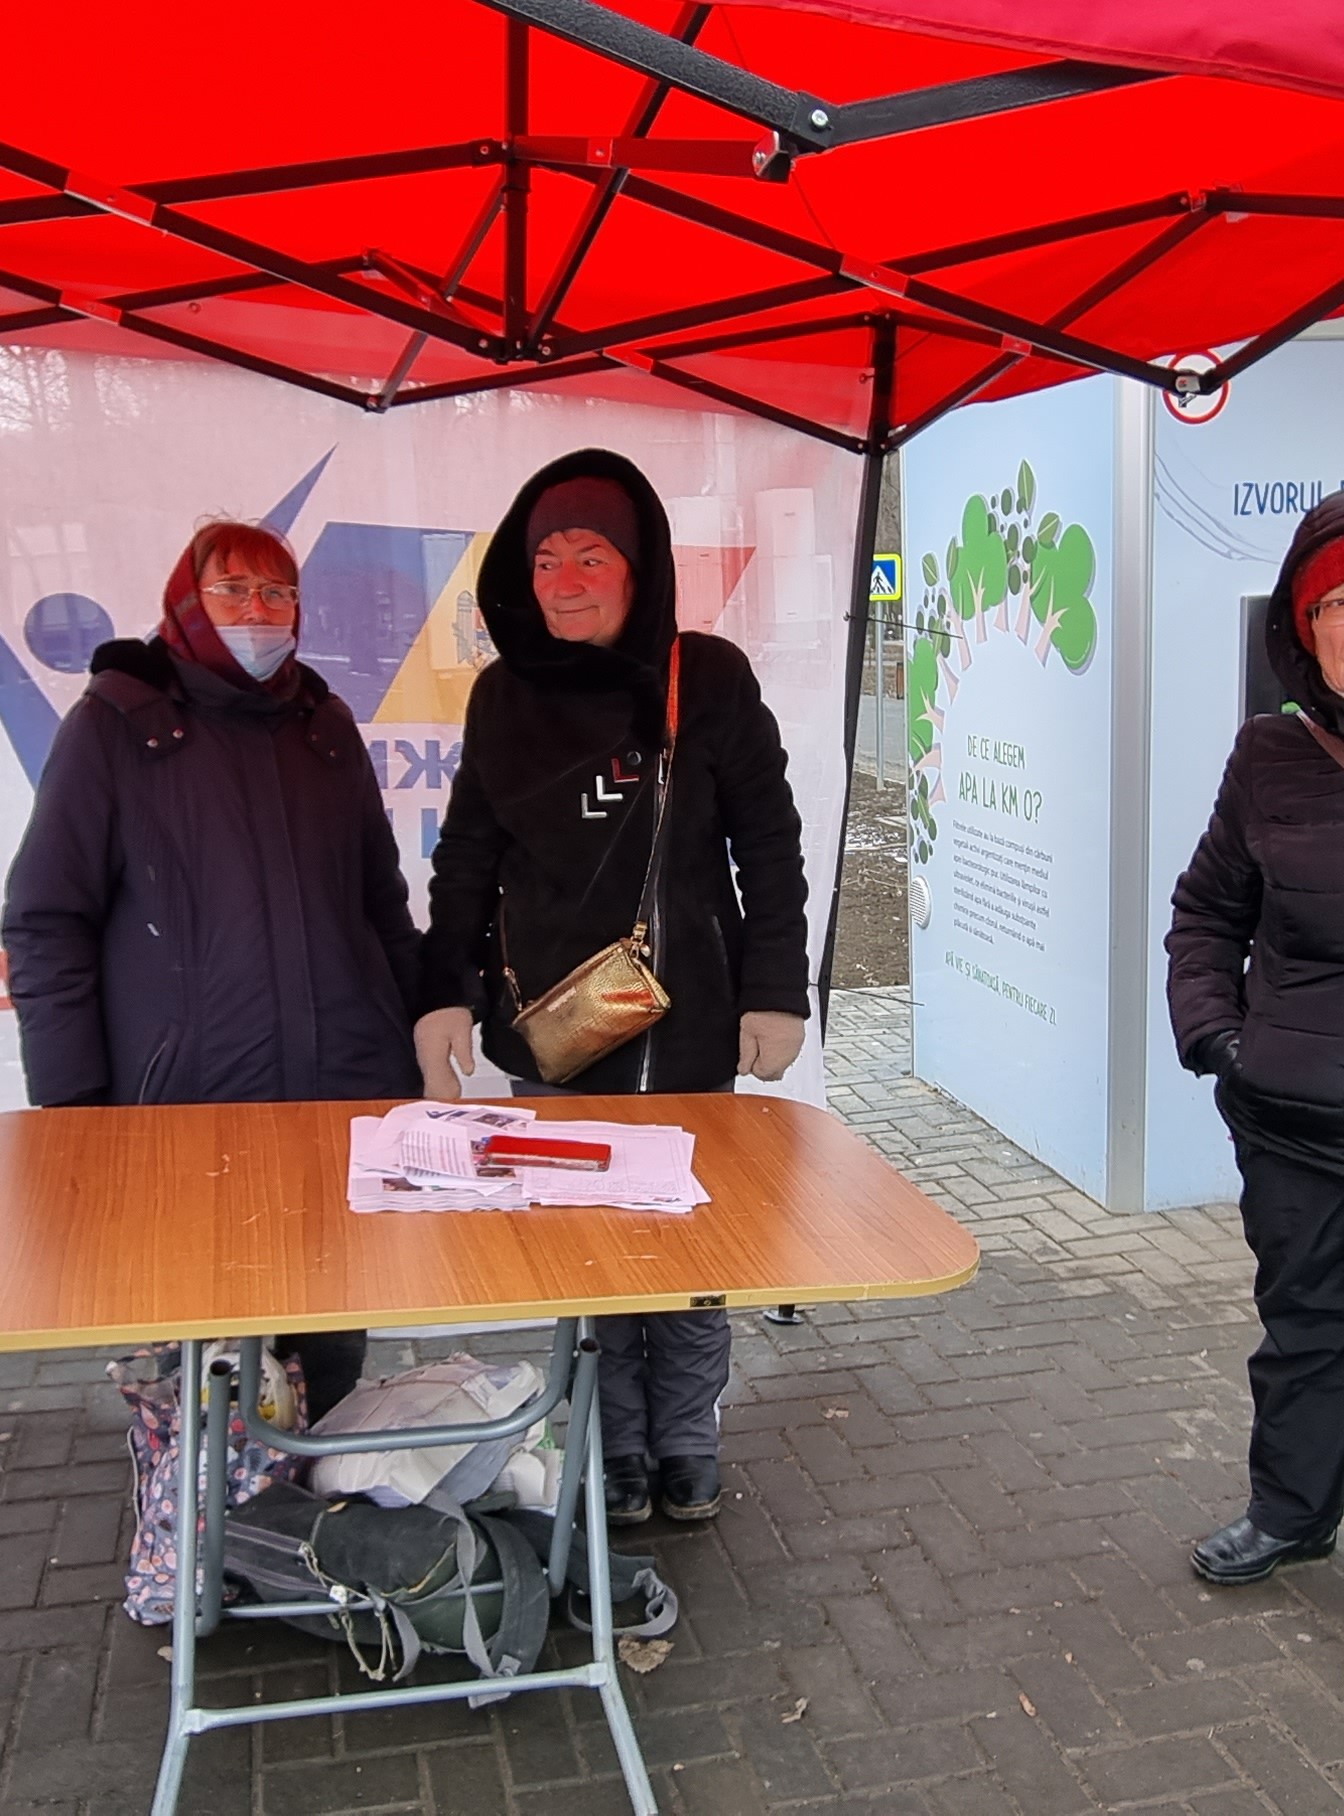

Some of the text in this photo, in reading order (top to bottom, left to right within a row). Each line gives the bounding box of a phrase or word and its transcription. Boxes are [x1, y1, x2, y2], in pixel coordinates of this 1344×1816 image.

[967, 734, 1026, 770] DE CE ALEGEM
[959, 771, 978, 805] APA
[982, 776, 997, 811] LA
[1001, 781, 1019, 818] KM
